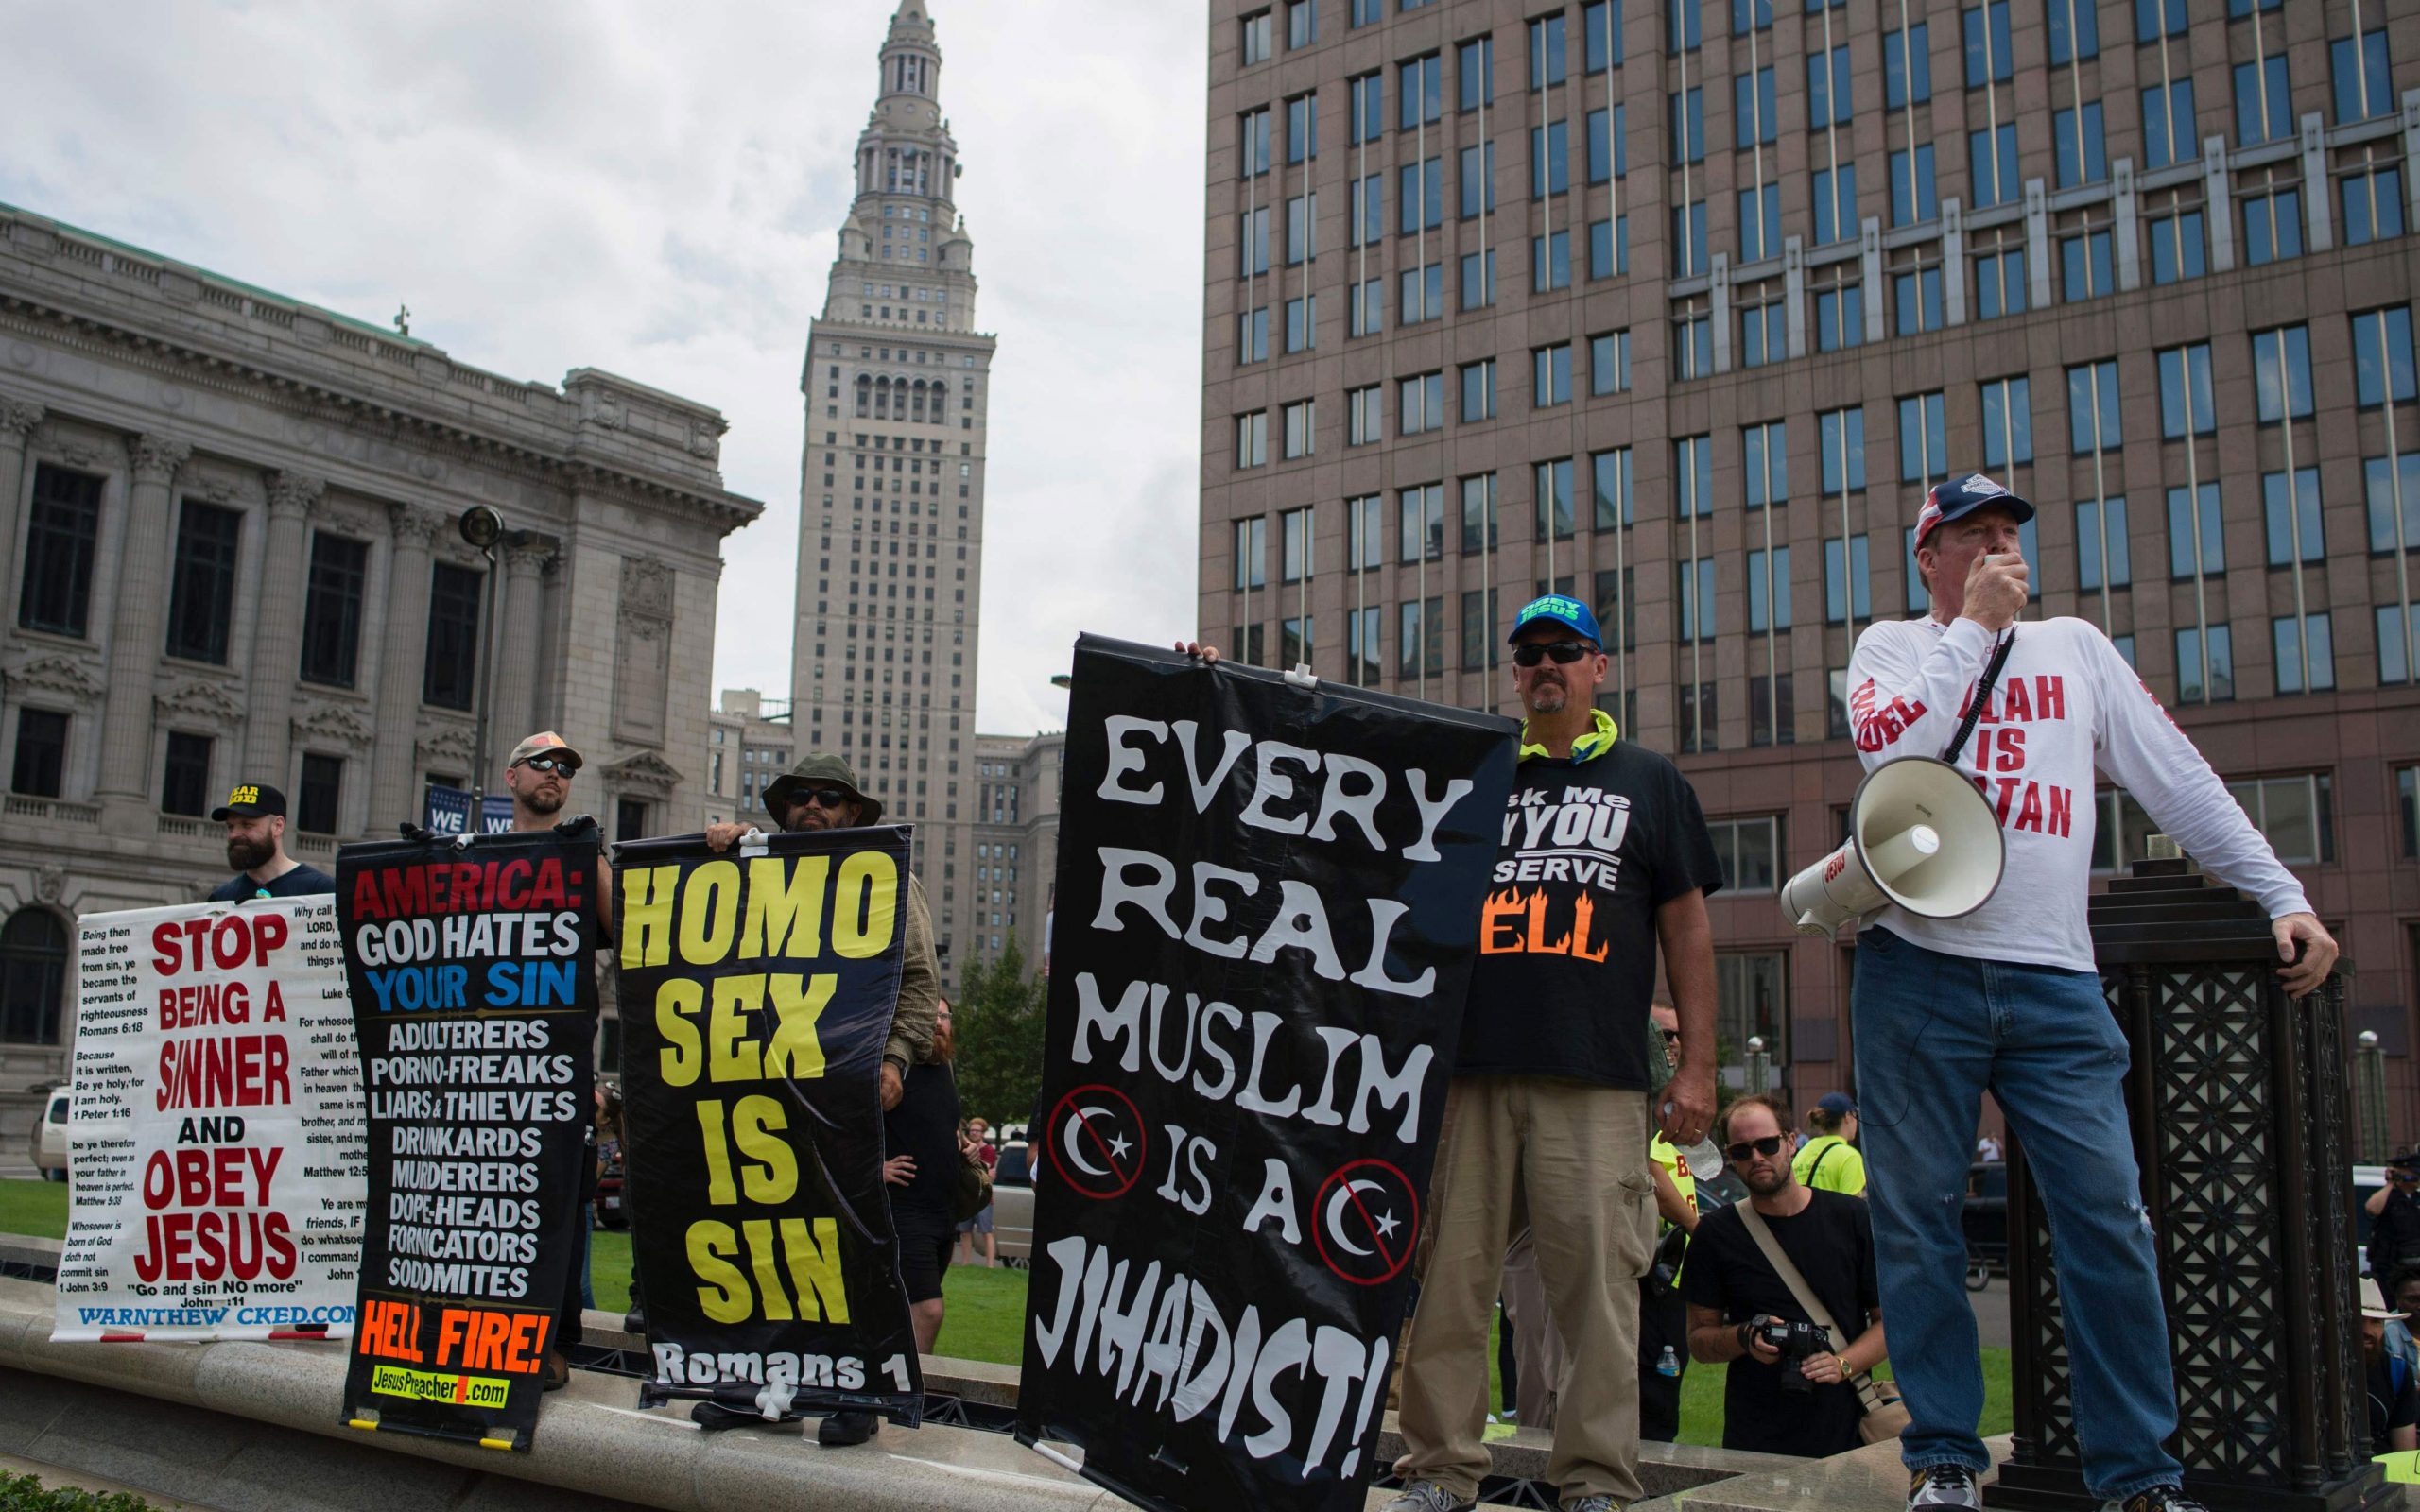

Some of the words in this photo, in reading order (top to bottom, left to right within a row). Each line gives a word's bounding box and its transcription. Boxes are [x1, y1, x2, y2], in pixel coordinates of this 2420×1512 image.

[1521, 597, 1581, 614] OBEY
[1519, 604, 1579, 625] JESUS
[1976, 728, 2025, 772] IS
[1097, 714, 1473, 862] EVERY
[1507, 787, 1549, 807] sk
[1562, 785, 1632, 809] Me
[1973, 776, 2072, 839] TAN
[432, 808, 463, 832] WE
[1522, 804, 1630, 851] YOU
[1493, 857, 1618, 891] SERVE
[353, 858, 583, 920] AMERICA:
[294, 906, 314, 919] Why
[317, 904, 332, 917] call
[620, 850, 898, 970] HOMO
[307, 922, 336, 934] LORD,
[1090, 847, 1436, 998] REAL
[1480, 885, 1609, 963] ELL
[82, 930, 106, 940] Being
[109, 927, 130, 937] then
[357, 919, 437, 966] GOD
[442, 911, 580, 959] HATES
[81, 945, 106, 956] made
[109, 944, 128, 954] free
[151, 913, 288, 976] STOP
[301, 939, 317, 951] and
[320, 939, 331, 949] do
[82, 963, 103, 972] from
[106, 960, 121, 971] sin,
[125, 960, 136, 971] ye
[307, 956, 335, 968] things
[82, 978, 118, 988] became
[121, 975, 137, 985] the
[364, 964, 468, 1011] YOUR
[484, 960, 577, 1007] SIN
[82, 992, 124, 1005] servants
[127, 990, 136, 1001] of
[322, 988, 343, 999] Luke
[159, 982, 250, 1030] BEING
[264, 979, 287, 1022] A
[81, 1007, 148, 1022] righteousness
[300, 1017, 314, 1027] For
[79, 1026, 118, 1037] Romans
[122, 1022, 143, 1033] 6:18
[389, 1019, 550, 1052] ADULTERERS
[655, 973, 838, 1087] SEX
[310, 1033, 333, 1044] shall
[335, 1032, 347, 1043] do
[76, 1052, 115, 1061] Because
[321, 1050, 337, 1060] will
[340, 1049, 350, 1059] of
[1071, 971, 1435, 1143] MUSLIM
[76, 1066, 83, 1075] it
[85, 1065, 94, 1074] is
[156, 1034, 291, 1112] SINNER
[301, 1067, 330, 1077] Father
[333, 1065, 359, 1076] which
[371, 1054, 574, 1086] PORNO-FREAKS
[76, 1081, 89, 1091] Be
[93, 1082, 103, 1091] ye
[131, 1078, 144, 1088] for
[304, 1083, 313, 1093] in
[315, 1083, 347, 1093] heaven
[320, 1101, 344, 1110] same
[346, 1099, 354, 1109] is
[371, 1091, 432, 1120] LIARS
[432, 1098, 441, 1119] &
[444, 1091, 577, 1122] THIEVES
[81, 1109, 108, 1120] Peter
[112, 1108, 130, 1118] 1:16
[302, 1117, 336, 1127] brother,
[337, 1116, 355, 1126] and
[177, 1116, 245, 1144] AND
[72, 1141, 83, 1150] be
[87, 1143, 97, 1151] ye
[101, 1139, 135, 1149] therefore
[306, 1134, 334, 1144] sister,
[336, 1133, 353, 1143] and
[392, 1126, 542, 1158] DRUNKARDS
[340, 1149, 368, 1160] mothe
[696, 1094, 799, 1205] IS
[75, 1170, 95, 1179] your
[143, 1146, 283, 1211] OBEY
[303, 1167, 345, 1177] Matthew
[391, 1160, 539, 1193] MURDERERS
[76, 1183, 103, 1192] heaven
[1156, 1125, 1217, 1216] IS
[1242, 1158, 1302, 1245] A
[76, 1196, 105, 1206] Matthew
[321, 1198, 335, 1210] Ye
[337, 1201, 357, 1210] are
[390, 1192, 541, 1229] DOPE-HEADS
[71, 1221, 112, 1231] Whosoever
[115, 1220, 122, 1229] is
[350, 1216, 361, 1228] IF
[68, 1237, 86, 1246] born
[87, 1237, 96, 1246] of
[96, 1236, 112, 1246] God
[133, 1211, 296, 1282] JESUS
[301, 1235, 315, 1246] do
[388, 1224, 538, 1263] FORNICATORS
[64, 1252, 81, 1262] doth
[83, 1253, 96, 1262] not
[308, 1251, 359, 1263] command
[60, 1267, 92, 1278] commit
[95, 1267, 109, 1277] sin
[327, 1269, 354, 1280] John
[388, 1257, 529, 1297] SODOMITES
[684, 1217, 850, 1324] SIN
[66, 1282, 90, 1292] John
[92, 1281, 109, 1292] 3:9
[163, 1282, 187, 1296] and
[193, 1281, 216, 1295] sin
[222, 1281, 248, 1294] NO
[181, 1297, 213, 1308] John
[359, 1300, 423, 1363] HELL
[436, 1308, 550, 1374] FIRE!
[1035, 1235, 1390, 1480] JIHADIST!
[652, 1342, 865, 1390] Romans
[881, 1354, 911, 1392] 1
